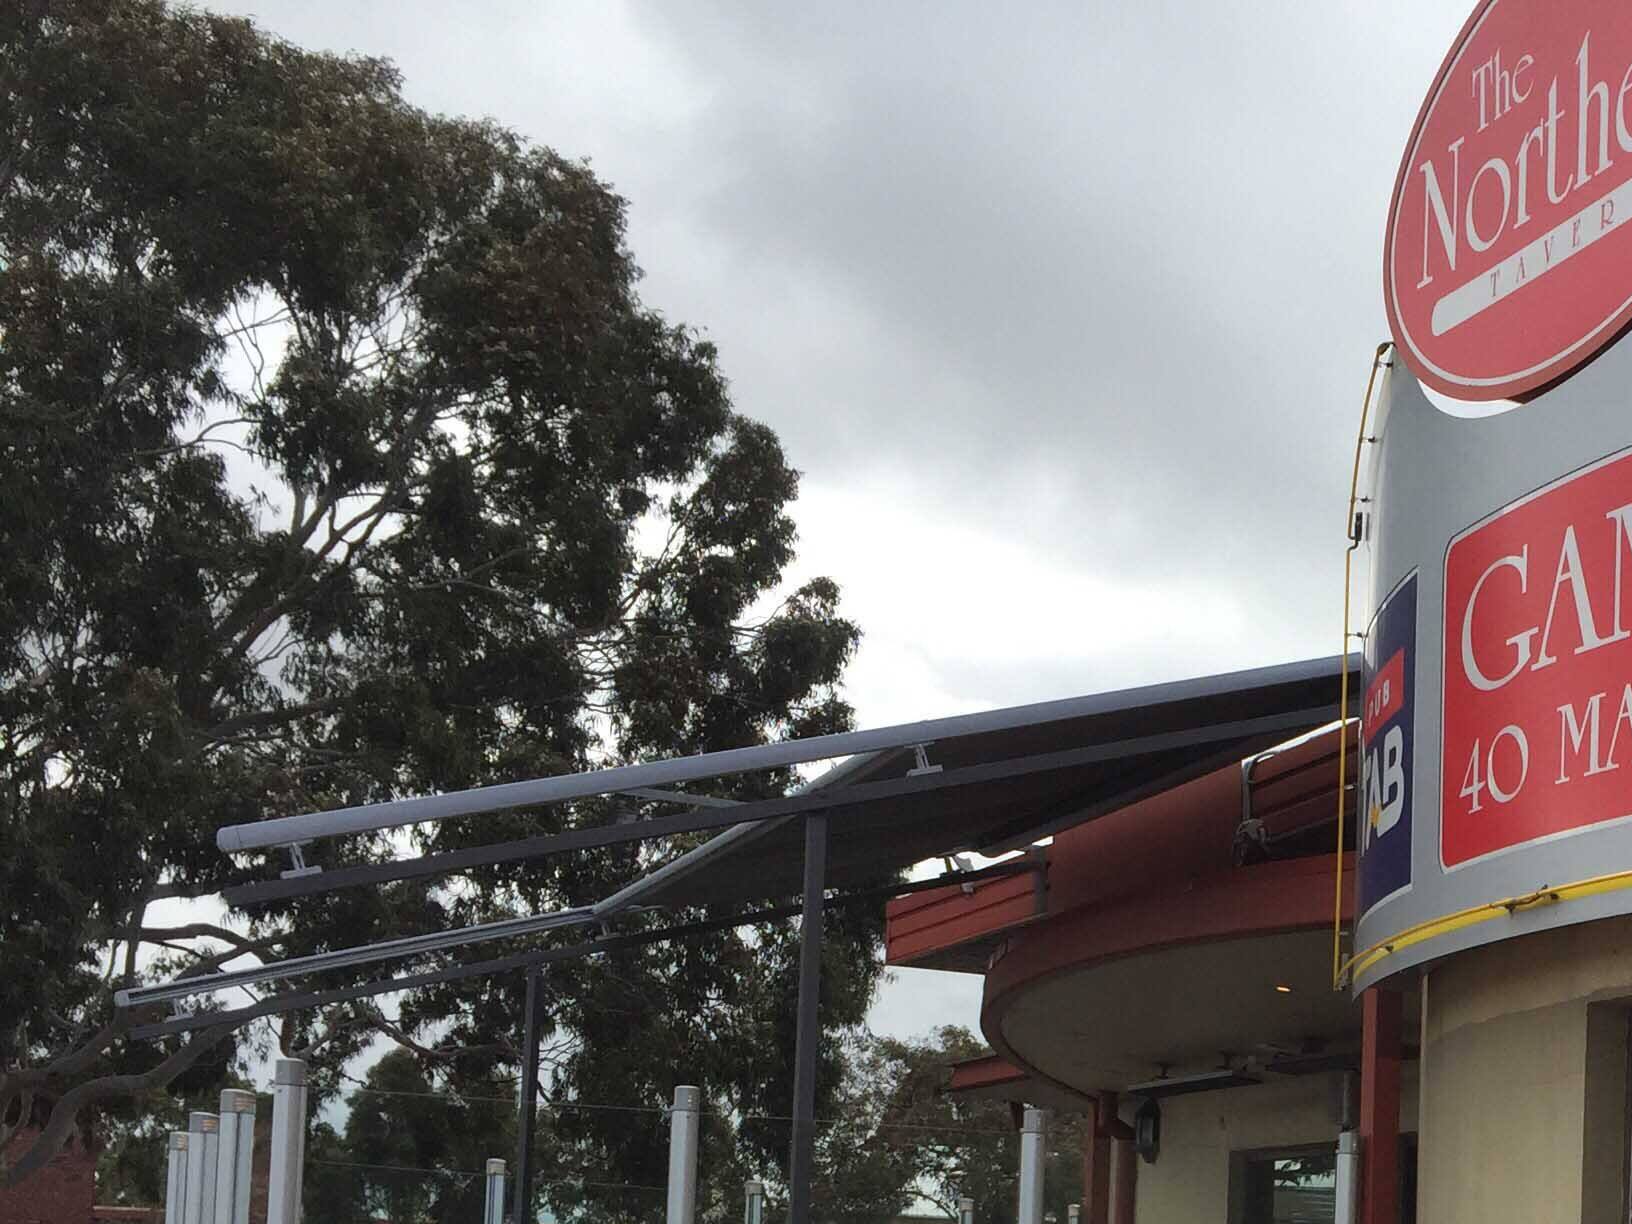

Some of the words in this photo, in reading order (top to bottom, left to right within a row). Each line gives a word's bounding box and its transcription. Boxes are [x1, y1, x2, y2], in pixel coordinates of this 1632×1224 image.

[1471, 47, 1535, 133] The
[1368, 679, 1390, 728] PUB
[1458, 723, 1530, 815] 40
